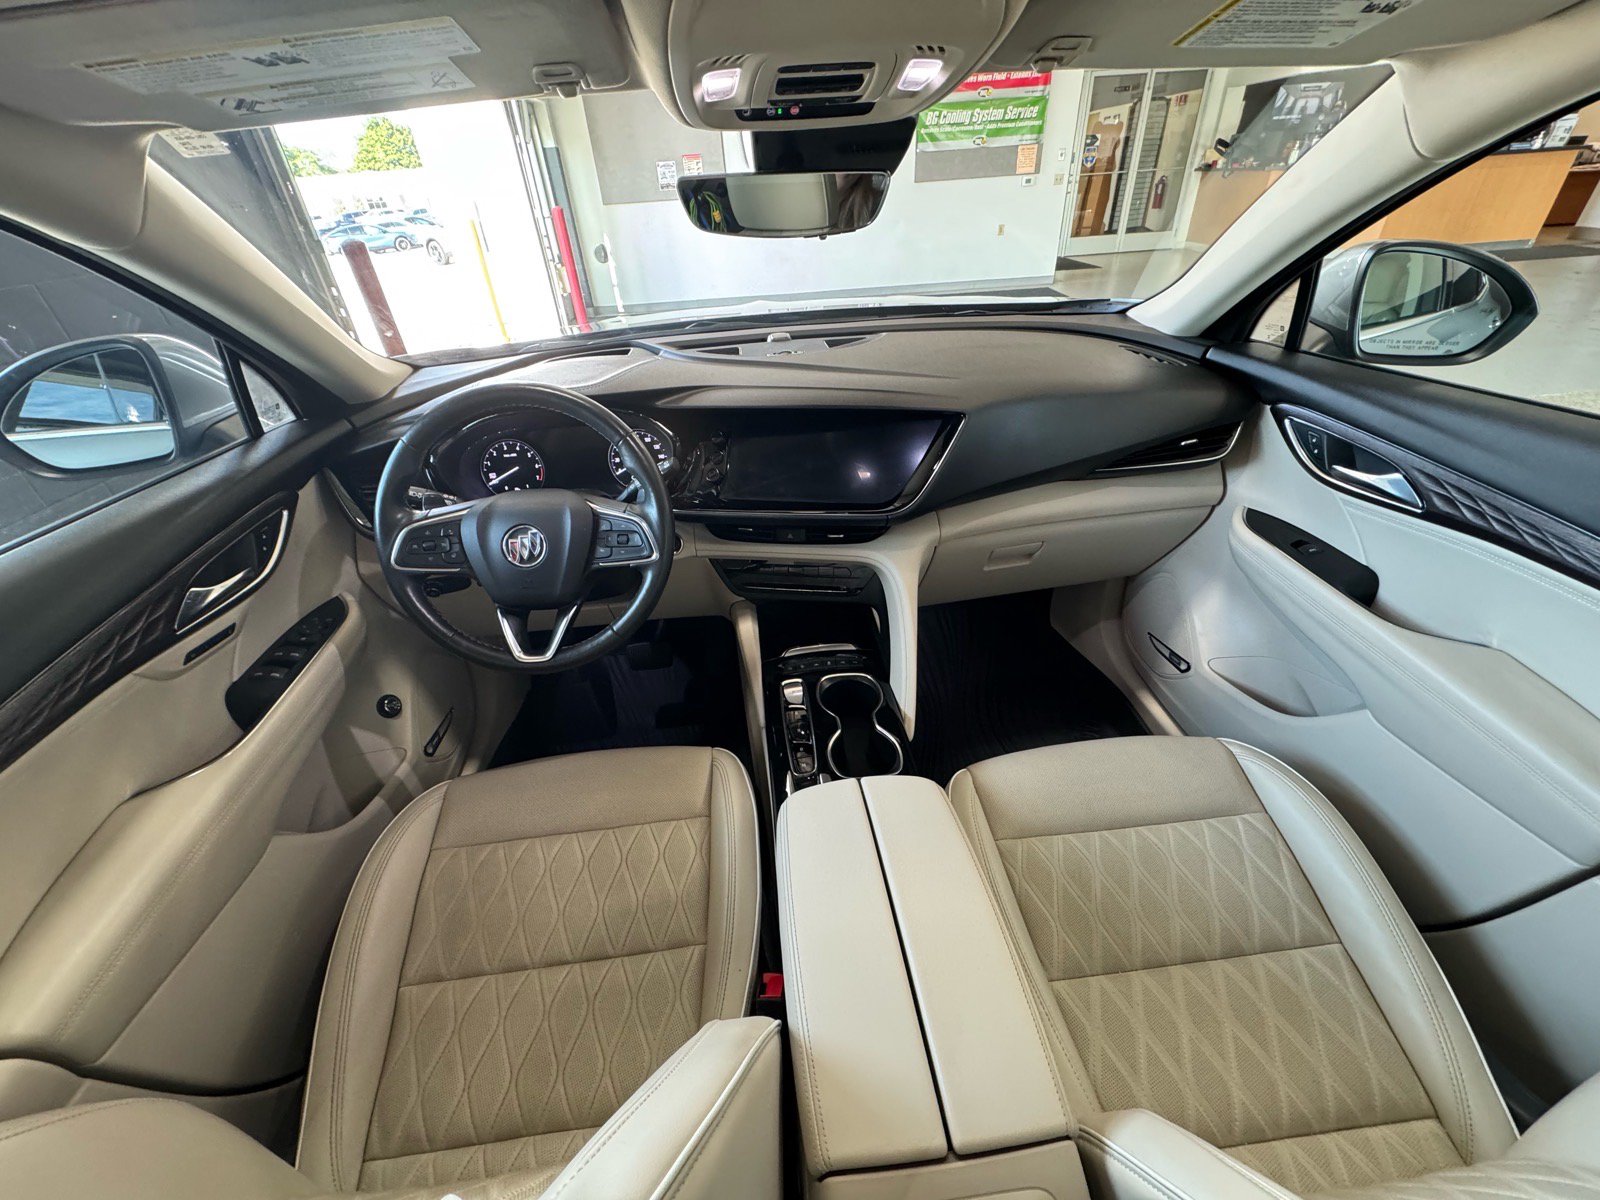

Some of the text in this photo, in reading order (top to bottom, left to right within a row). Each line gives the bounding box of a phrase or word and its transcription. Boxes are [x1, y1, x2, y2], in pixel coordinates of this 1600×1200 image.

[977, 74, 992, 82] Worn
[993, 72, 1006, 80] Fluid
[925, 104, 1040, 125] BG Cooling System Service
